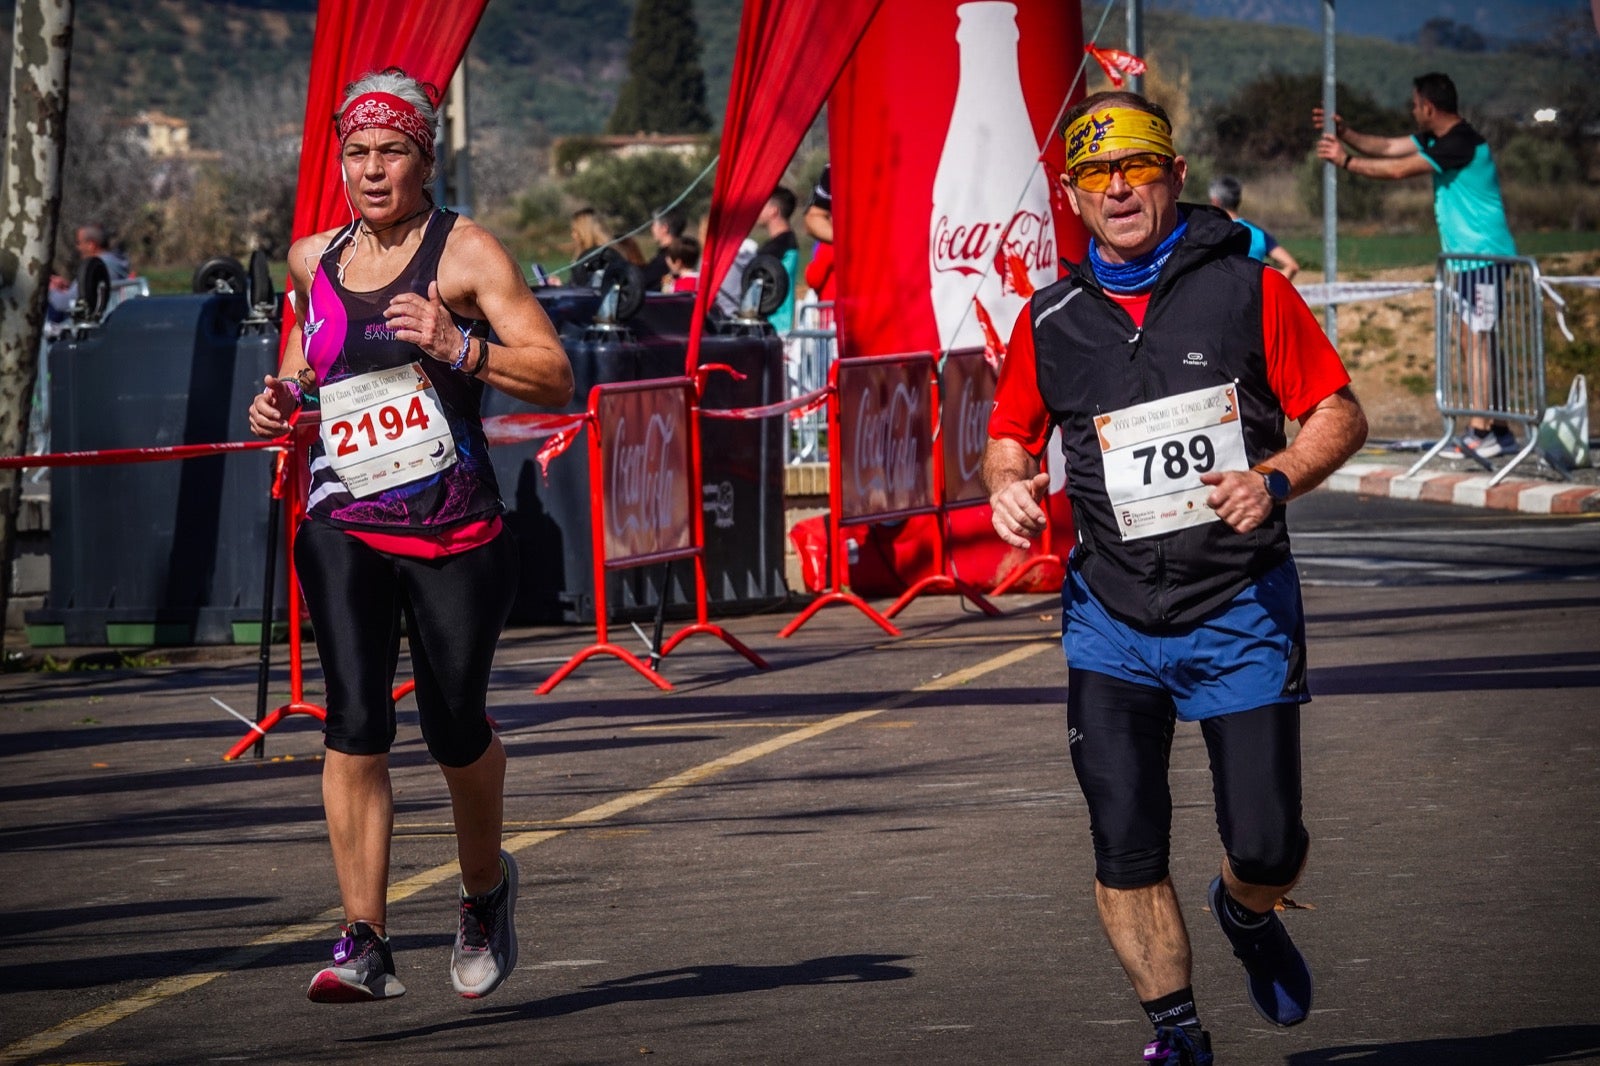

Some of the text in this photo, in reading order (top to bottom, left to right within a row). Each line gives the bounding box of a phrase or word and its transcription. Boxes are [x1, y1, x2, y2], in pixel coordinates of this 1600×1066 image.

[1183, 359, 1208, 367] Kalenji
[331, 396, 430, 458] 2194
[1132, 434, 1216, 485] 789
